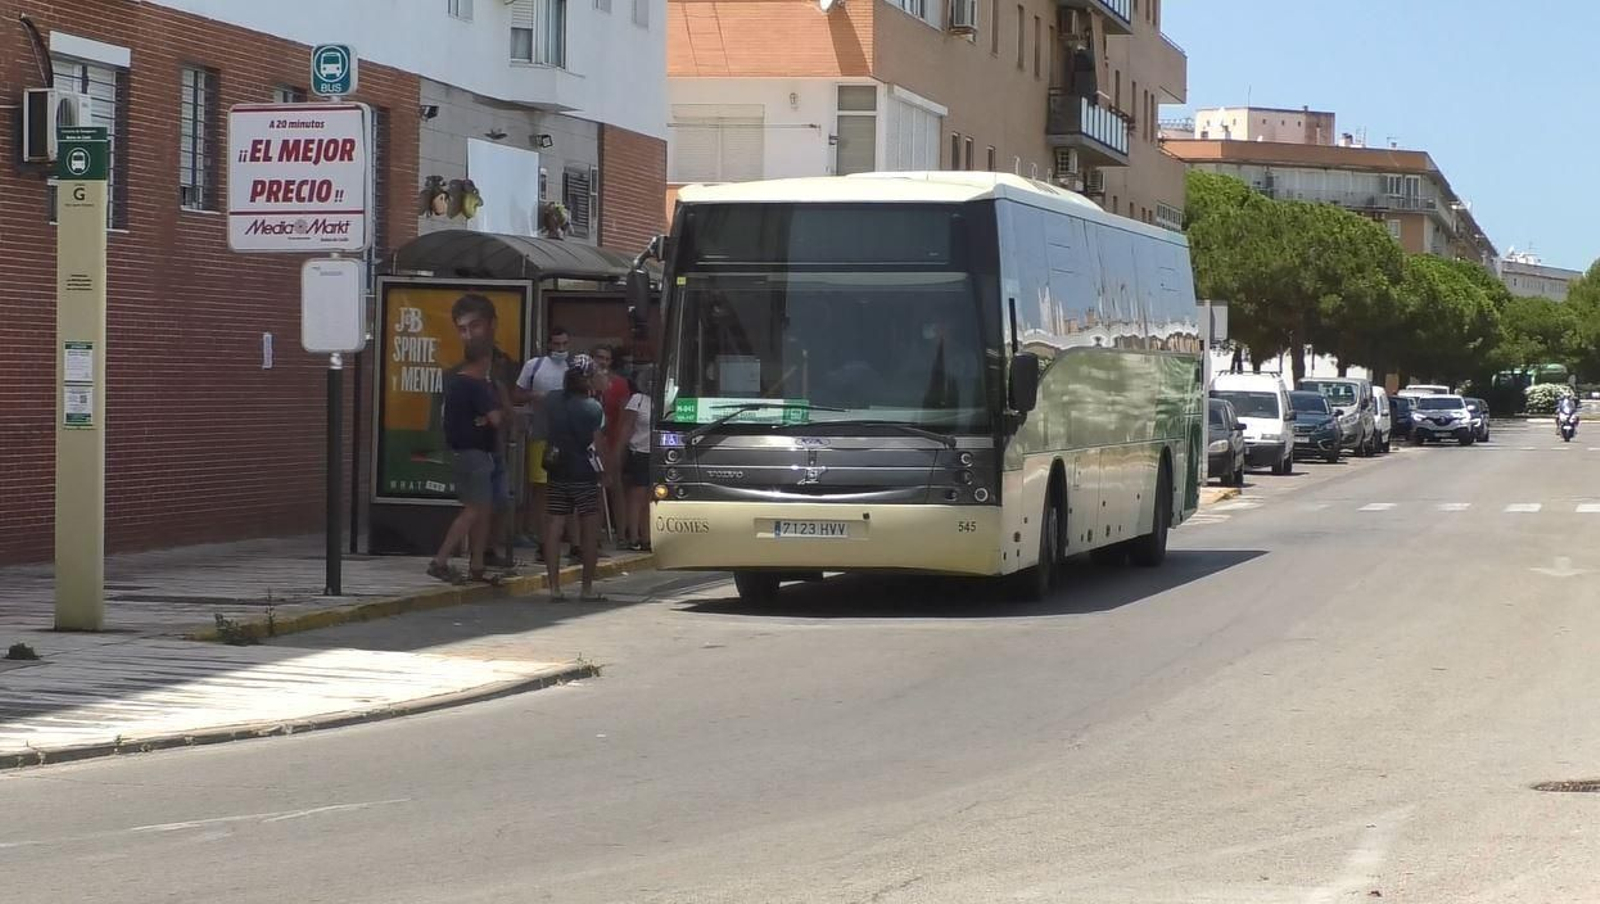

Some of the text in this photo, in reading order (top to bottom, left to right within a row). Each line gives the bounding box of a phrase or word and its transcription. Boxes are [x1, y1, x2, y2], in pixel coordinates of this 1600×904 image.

[320, 83, 342, 93] BUS
[269, 119, 325, 129] A 20 minutos
[277, 138, 356, 165] MEJOR
[73, 187, 86, 201] G
[244, 218, 351, 235] Media Markt
[392, 336, 438, 363] SPRITE
[401, 366, 444, 393] MENTA
[782, 522, 847, 536] 7123 HVV
[958, 520, 977, 533] 545
